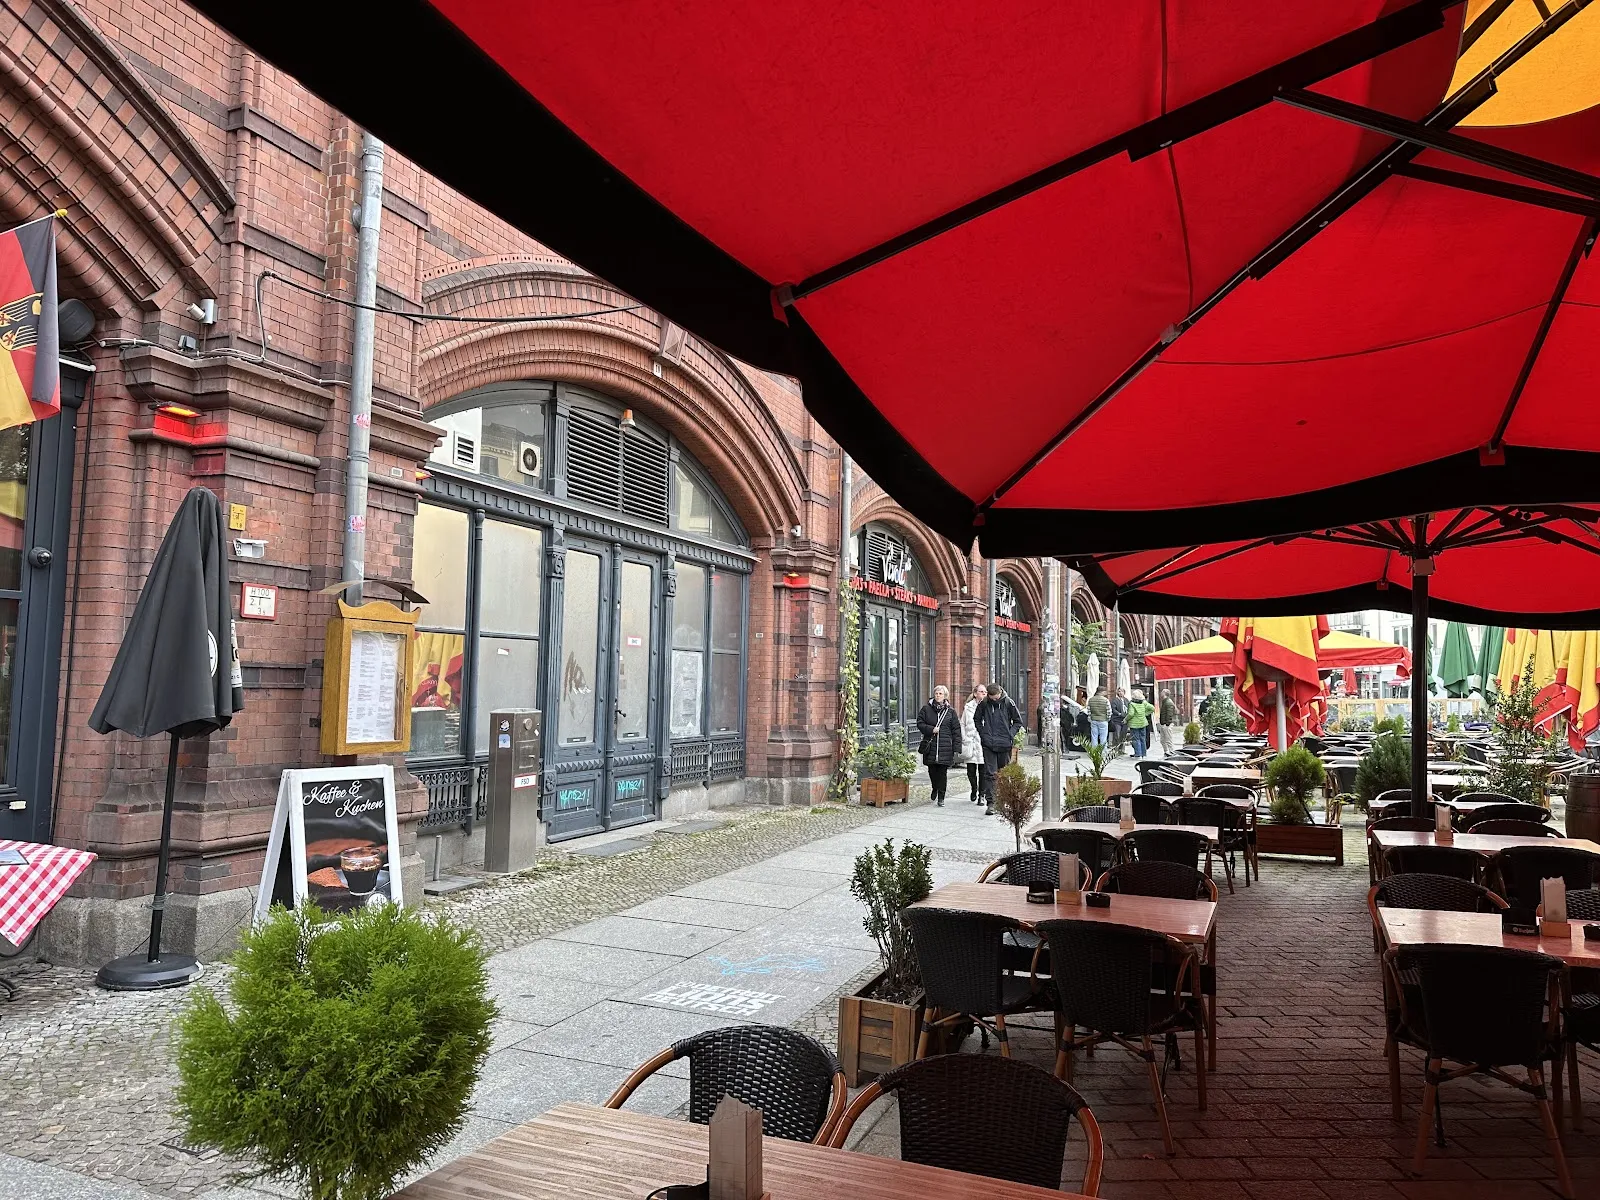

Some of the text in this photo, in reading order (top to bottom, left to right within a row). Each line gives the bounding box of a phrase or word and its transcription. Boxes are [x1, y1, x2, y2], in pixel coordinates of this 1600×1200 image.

[868, 580, 890, 598] PAELLA
[895, 585, 913, 604] STEAKS
[303, 780, 363, 805] Kaffee &
[335, 796, 384, 818] Kuchen
